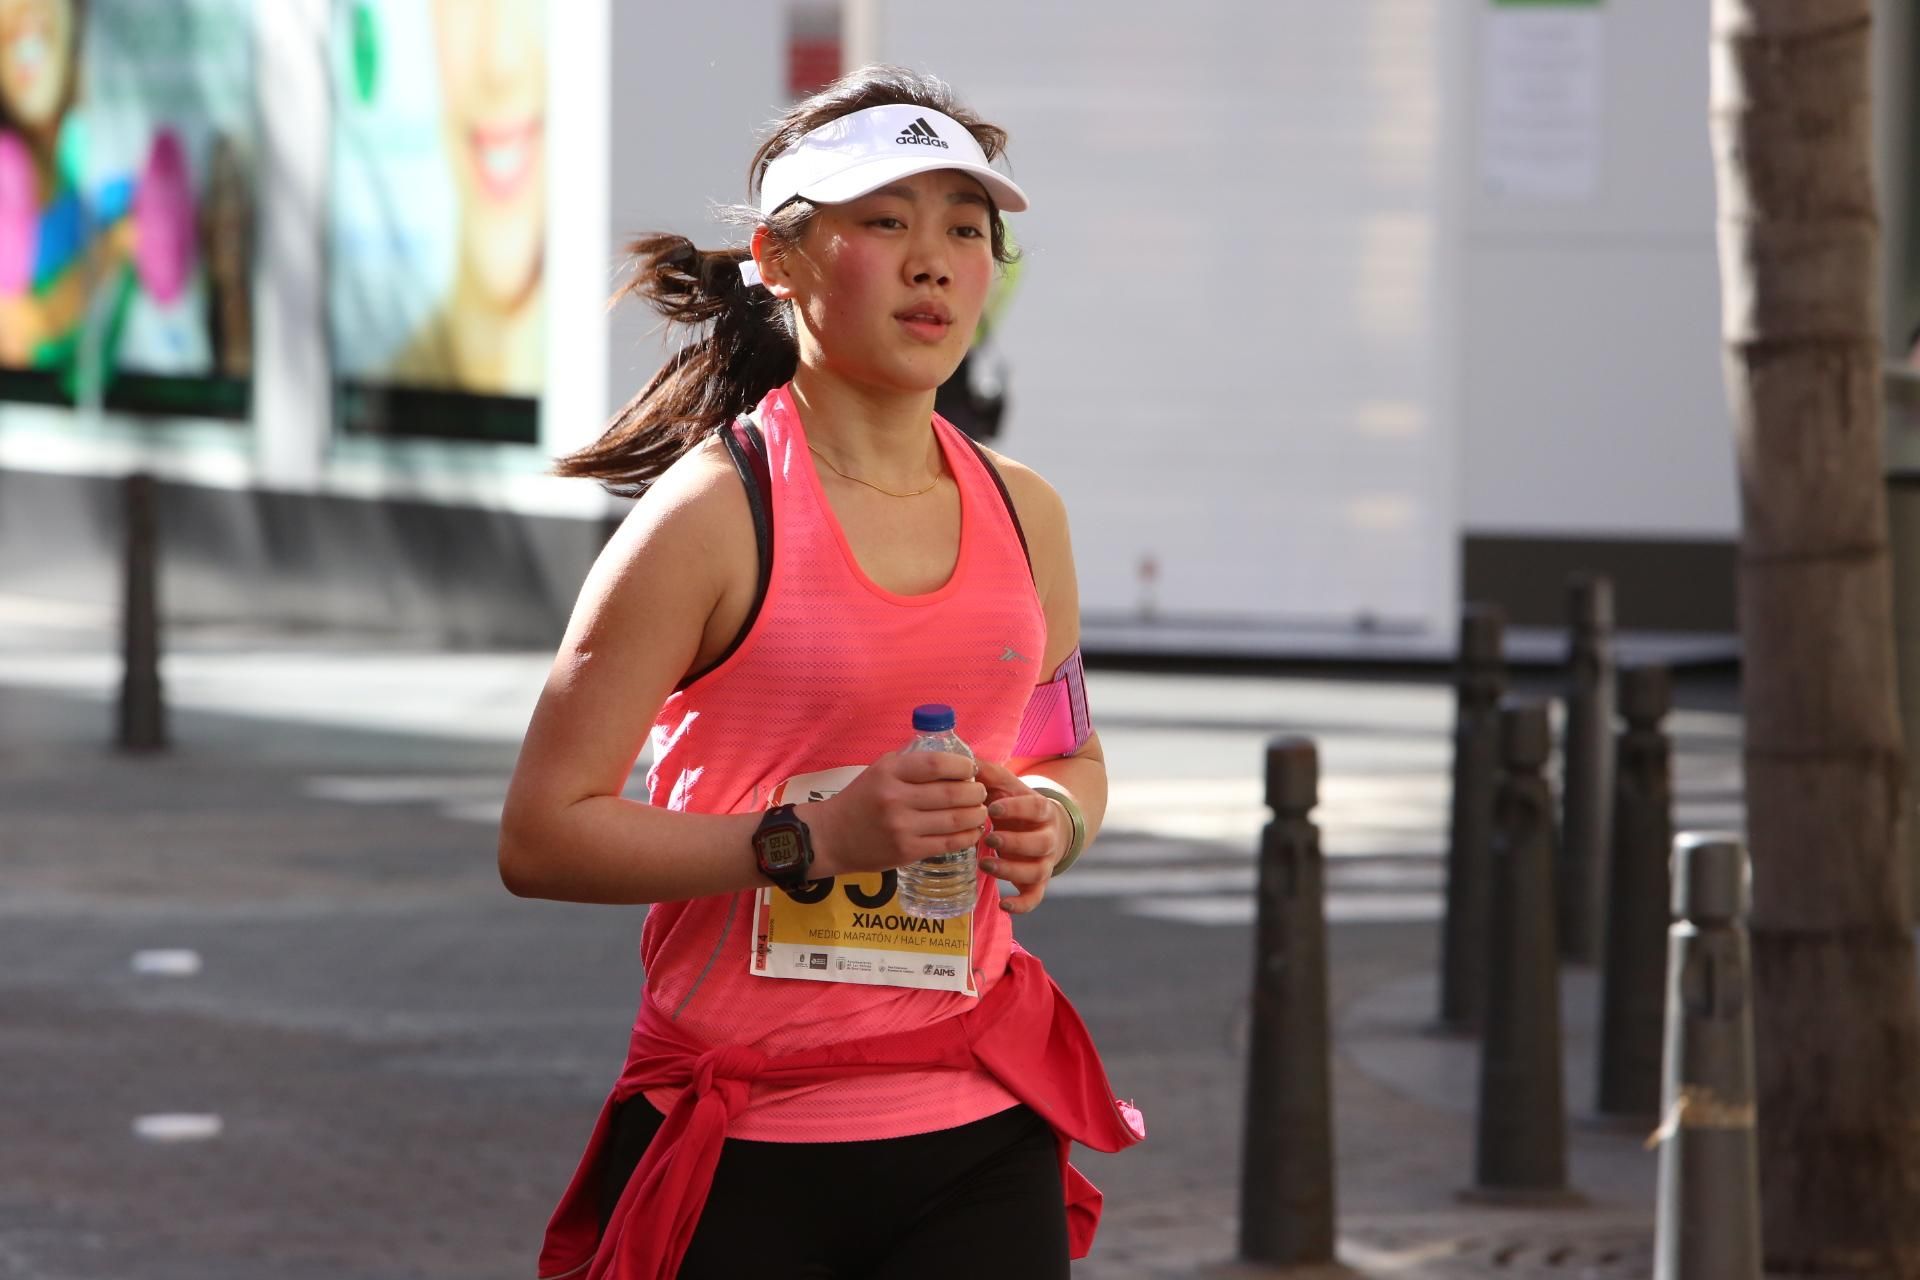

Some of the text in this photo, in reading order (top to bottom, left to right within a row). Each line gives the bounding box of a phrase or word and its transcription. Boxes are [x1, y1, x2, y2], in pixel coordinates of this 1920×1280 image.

[895, 134, 949, 149] adidas
[852, 913, 945, 934] XIAOWAN
[809, 929, 841, 939] MEDIO
[844, 932, 892, 944] MARATÓN
[900, 935, 926, 947] HALF
[933, 968, 956, 977] AIMS
